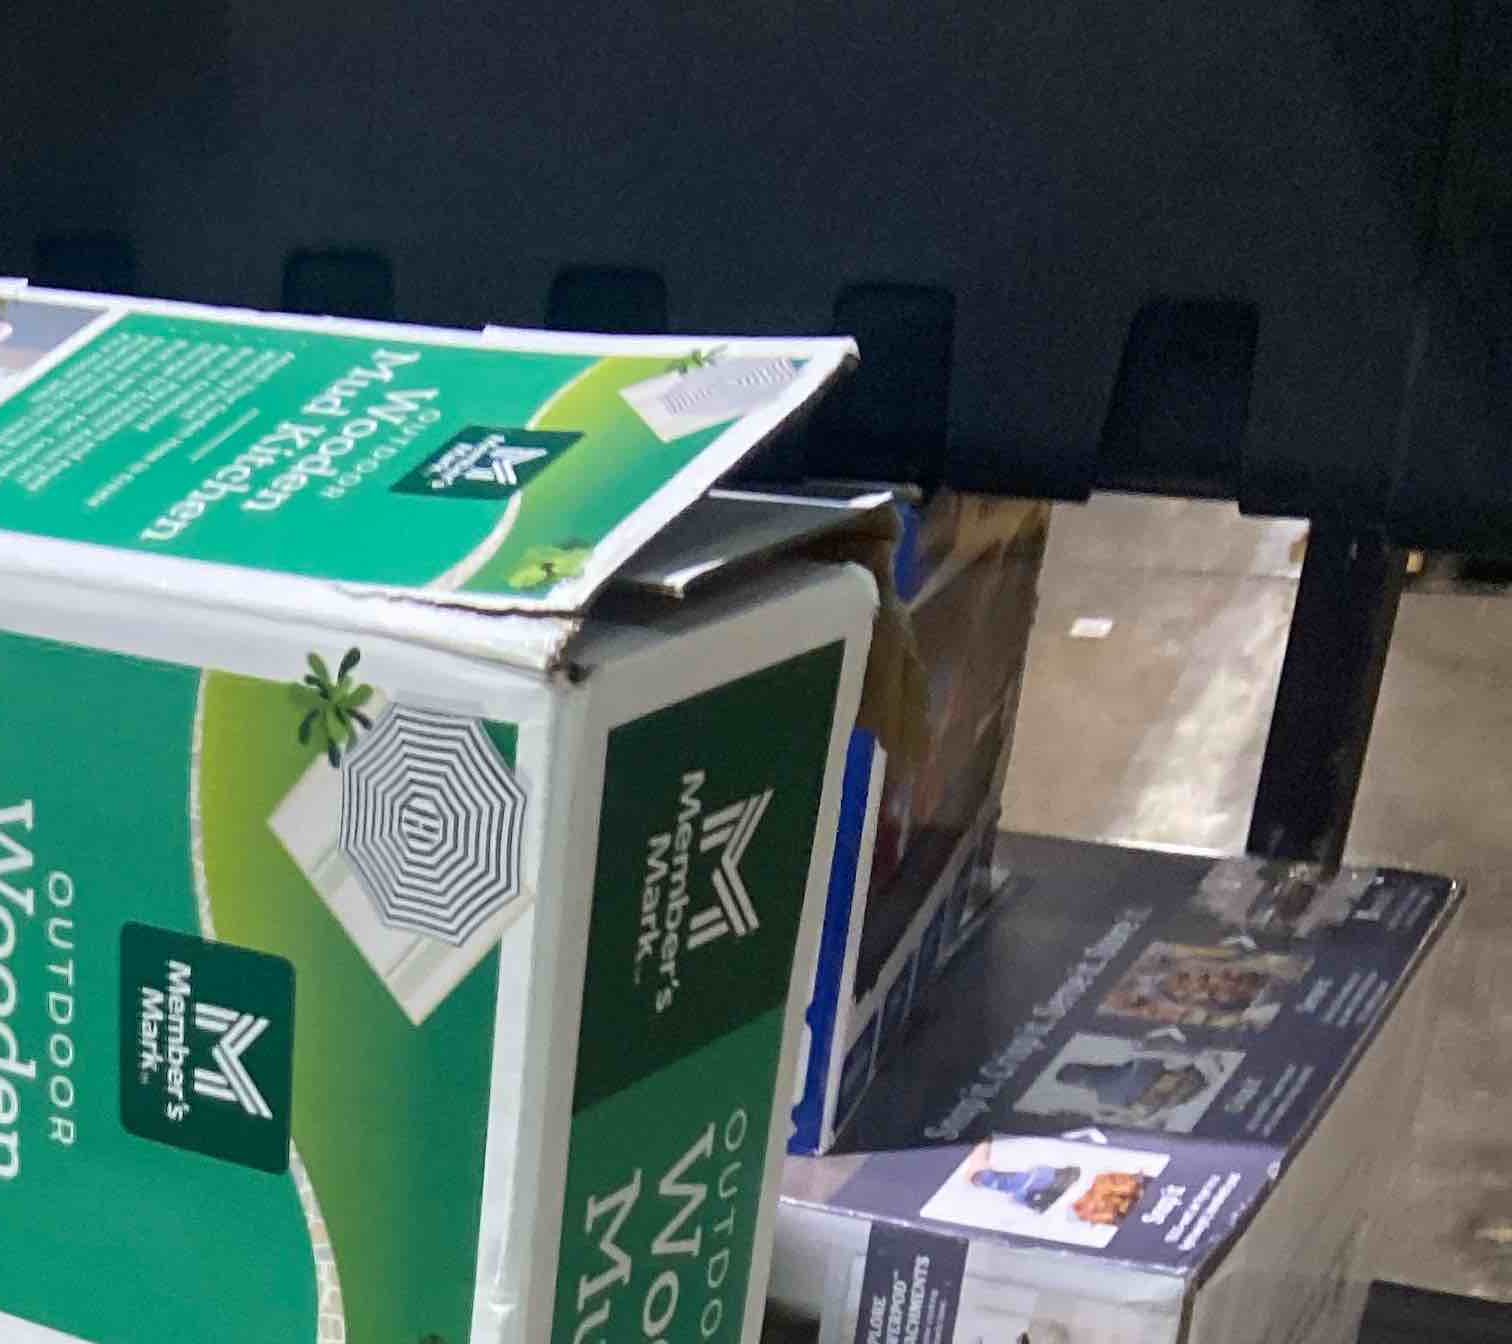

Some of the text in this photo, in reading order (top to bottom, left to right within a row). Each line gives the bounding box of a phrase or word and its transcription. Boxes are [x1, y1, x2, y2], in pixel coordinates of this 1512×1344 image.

[242, 387, 439, 511] Wooden
[302, 348, 420, 416] Mud
[141, 420, 324, 541] Kitchen
[654, 770, 705, 1013] Member's
[47, 870, 76, 1148] OUTDOOR
[164, 959, 191, 1121] Member's
